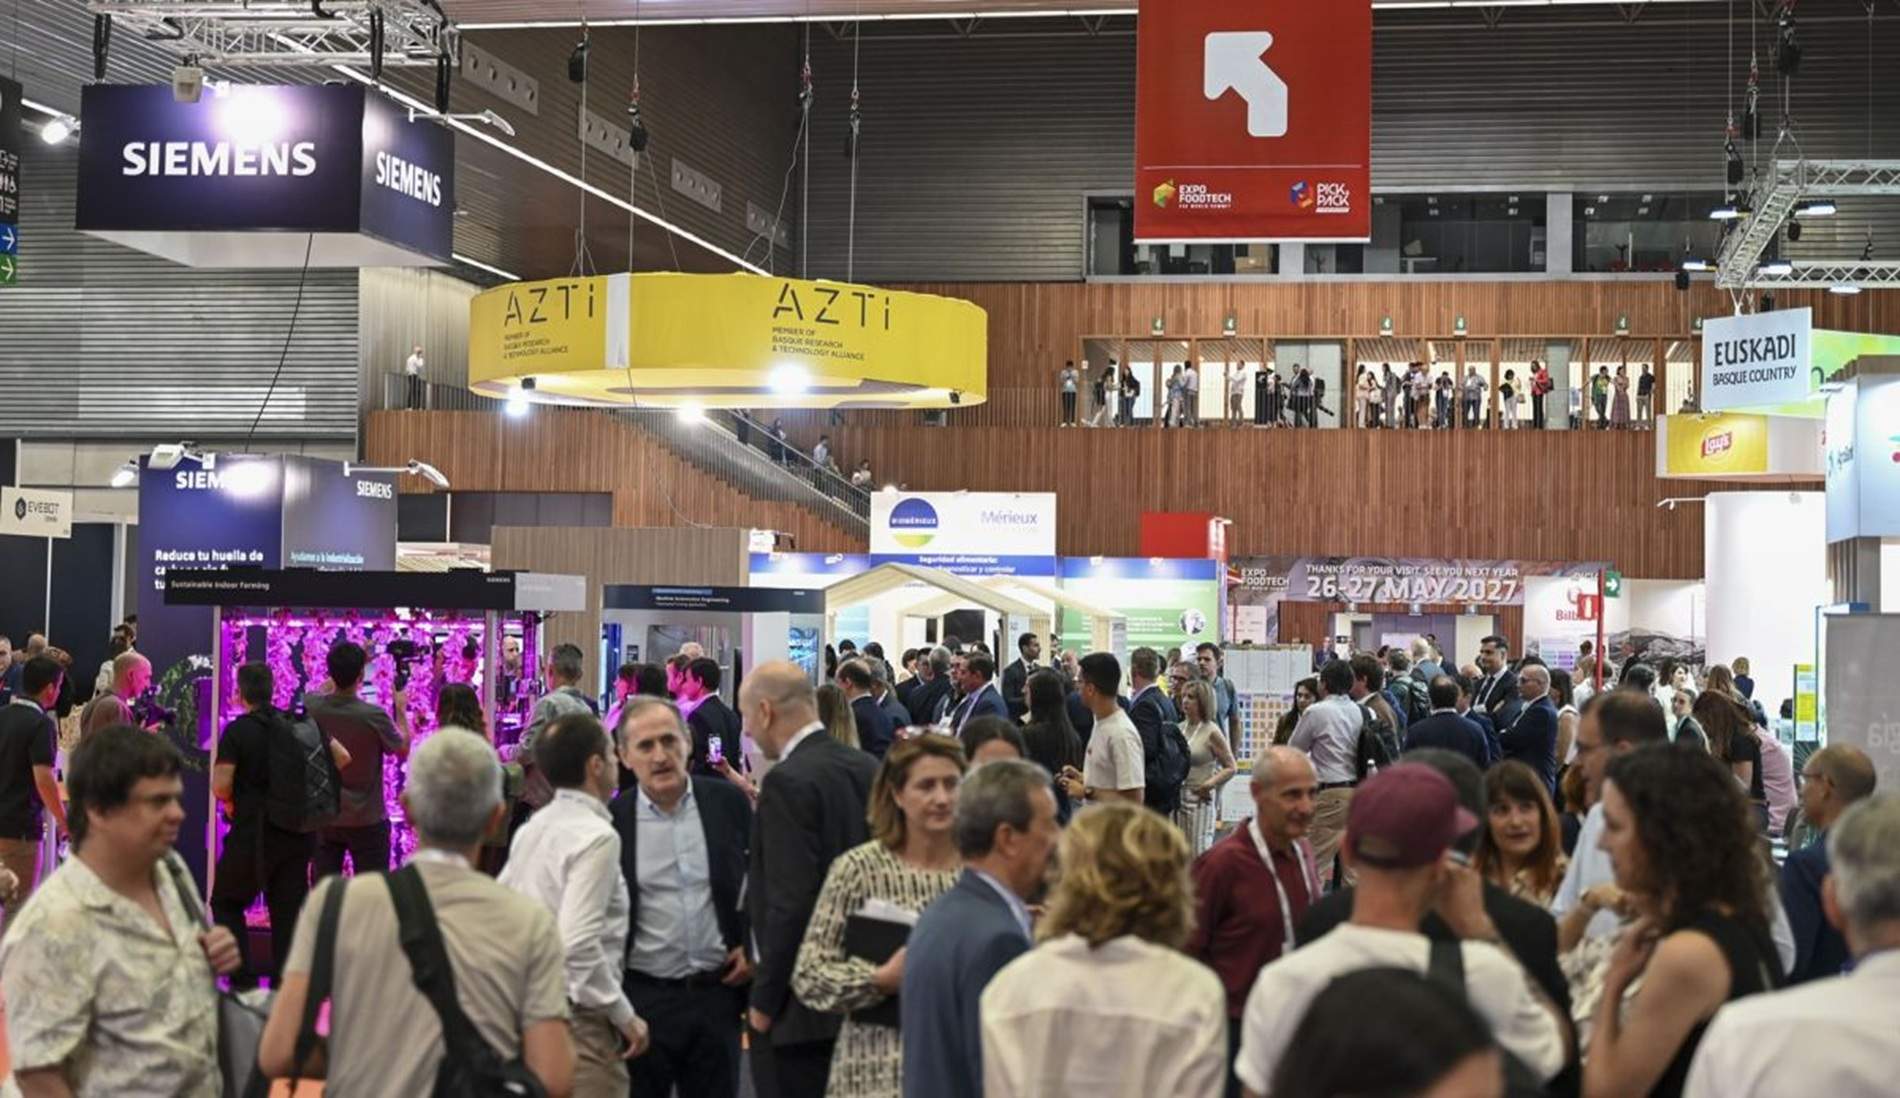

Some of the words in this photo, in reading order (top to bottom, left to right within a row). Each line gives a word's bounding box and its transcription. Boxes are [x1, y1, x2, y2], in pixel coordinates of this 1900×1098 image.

[122, 141, 316, 176] SIEMENS
[376, 151, 441, 206] SIEMENS
[1179, 184, 1206, 194] EXPO
[1179, 193, 1231, 203] FOODTECH
[772, 327, 803, 335] MEMBER
[772, 336, 802, 344] BASQUE
[805, 338, 843, 348] RESEARCH
[780, 346, 829, 356] TECHNOLOGY
[831, 351, 865, 360] ALLIANCE
[1714, 333, 1796, 367] EUSKADI
[1713, 371, 1747, 386] BASQUE
[1749, 366, 1797, 382] COUNTRY
[356, 480, 392, 499] SIEMENS
[981, 510, 1038, 524] Mérieux
[155, 549, 196, 561] Reduce
[197, 550, 209, 561] tu
[211, 549, 246, 561] huella
[249, 550, 264, 561] de
[919, 556, 955, 564] Seguridad
[1241, 568, 1267, 576] EXPO
[1305, 564, 1344, 574] THANKS
[1347, 565, 1365, 575] FOR
[1367, 566, 1393, 575] YOUR
[1424, 567, 1441, 576] SEE
[1443, 567, 1462, 576] YOU
[1465, 567, 1490, 576] NEXT
[1492, 568, 1518, 577] YEAR
[155, 580, 166, 590] tu
[171, 580, 213, 589] Sustainable
[215, 581, 238, 589] Indoor
[240, 581, 270, 591] Farming
[1307, 576, 1378, 600] 26-27
[1384, 576, 1448, 600] MAY
[1454, 578, 1517, 601] 2027
